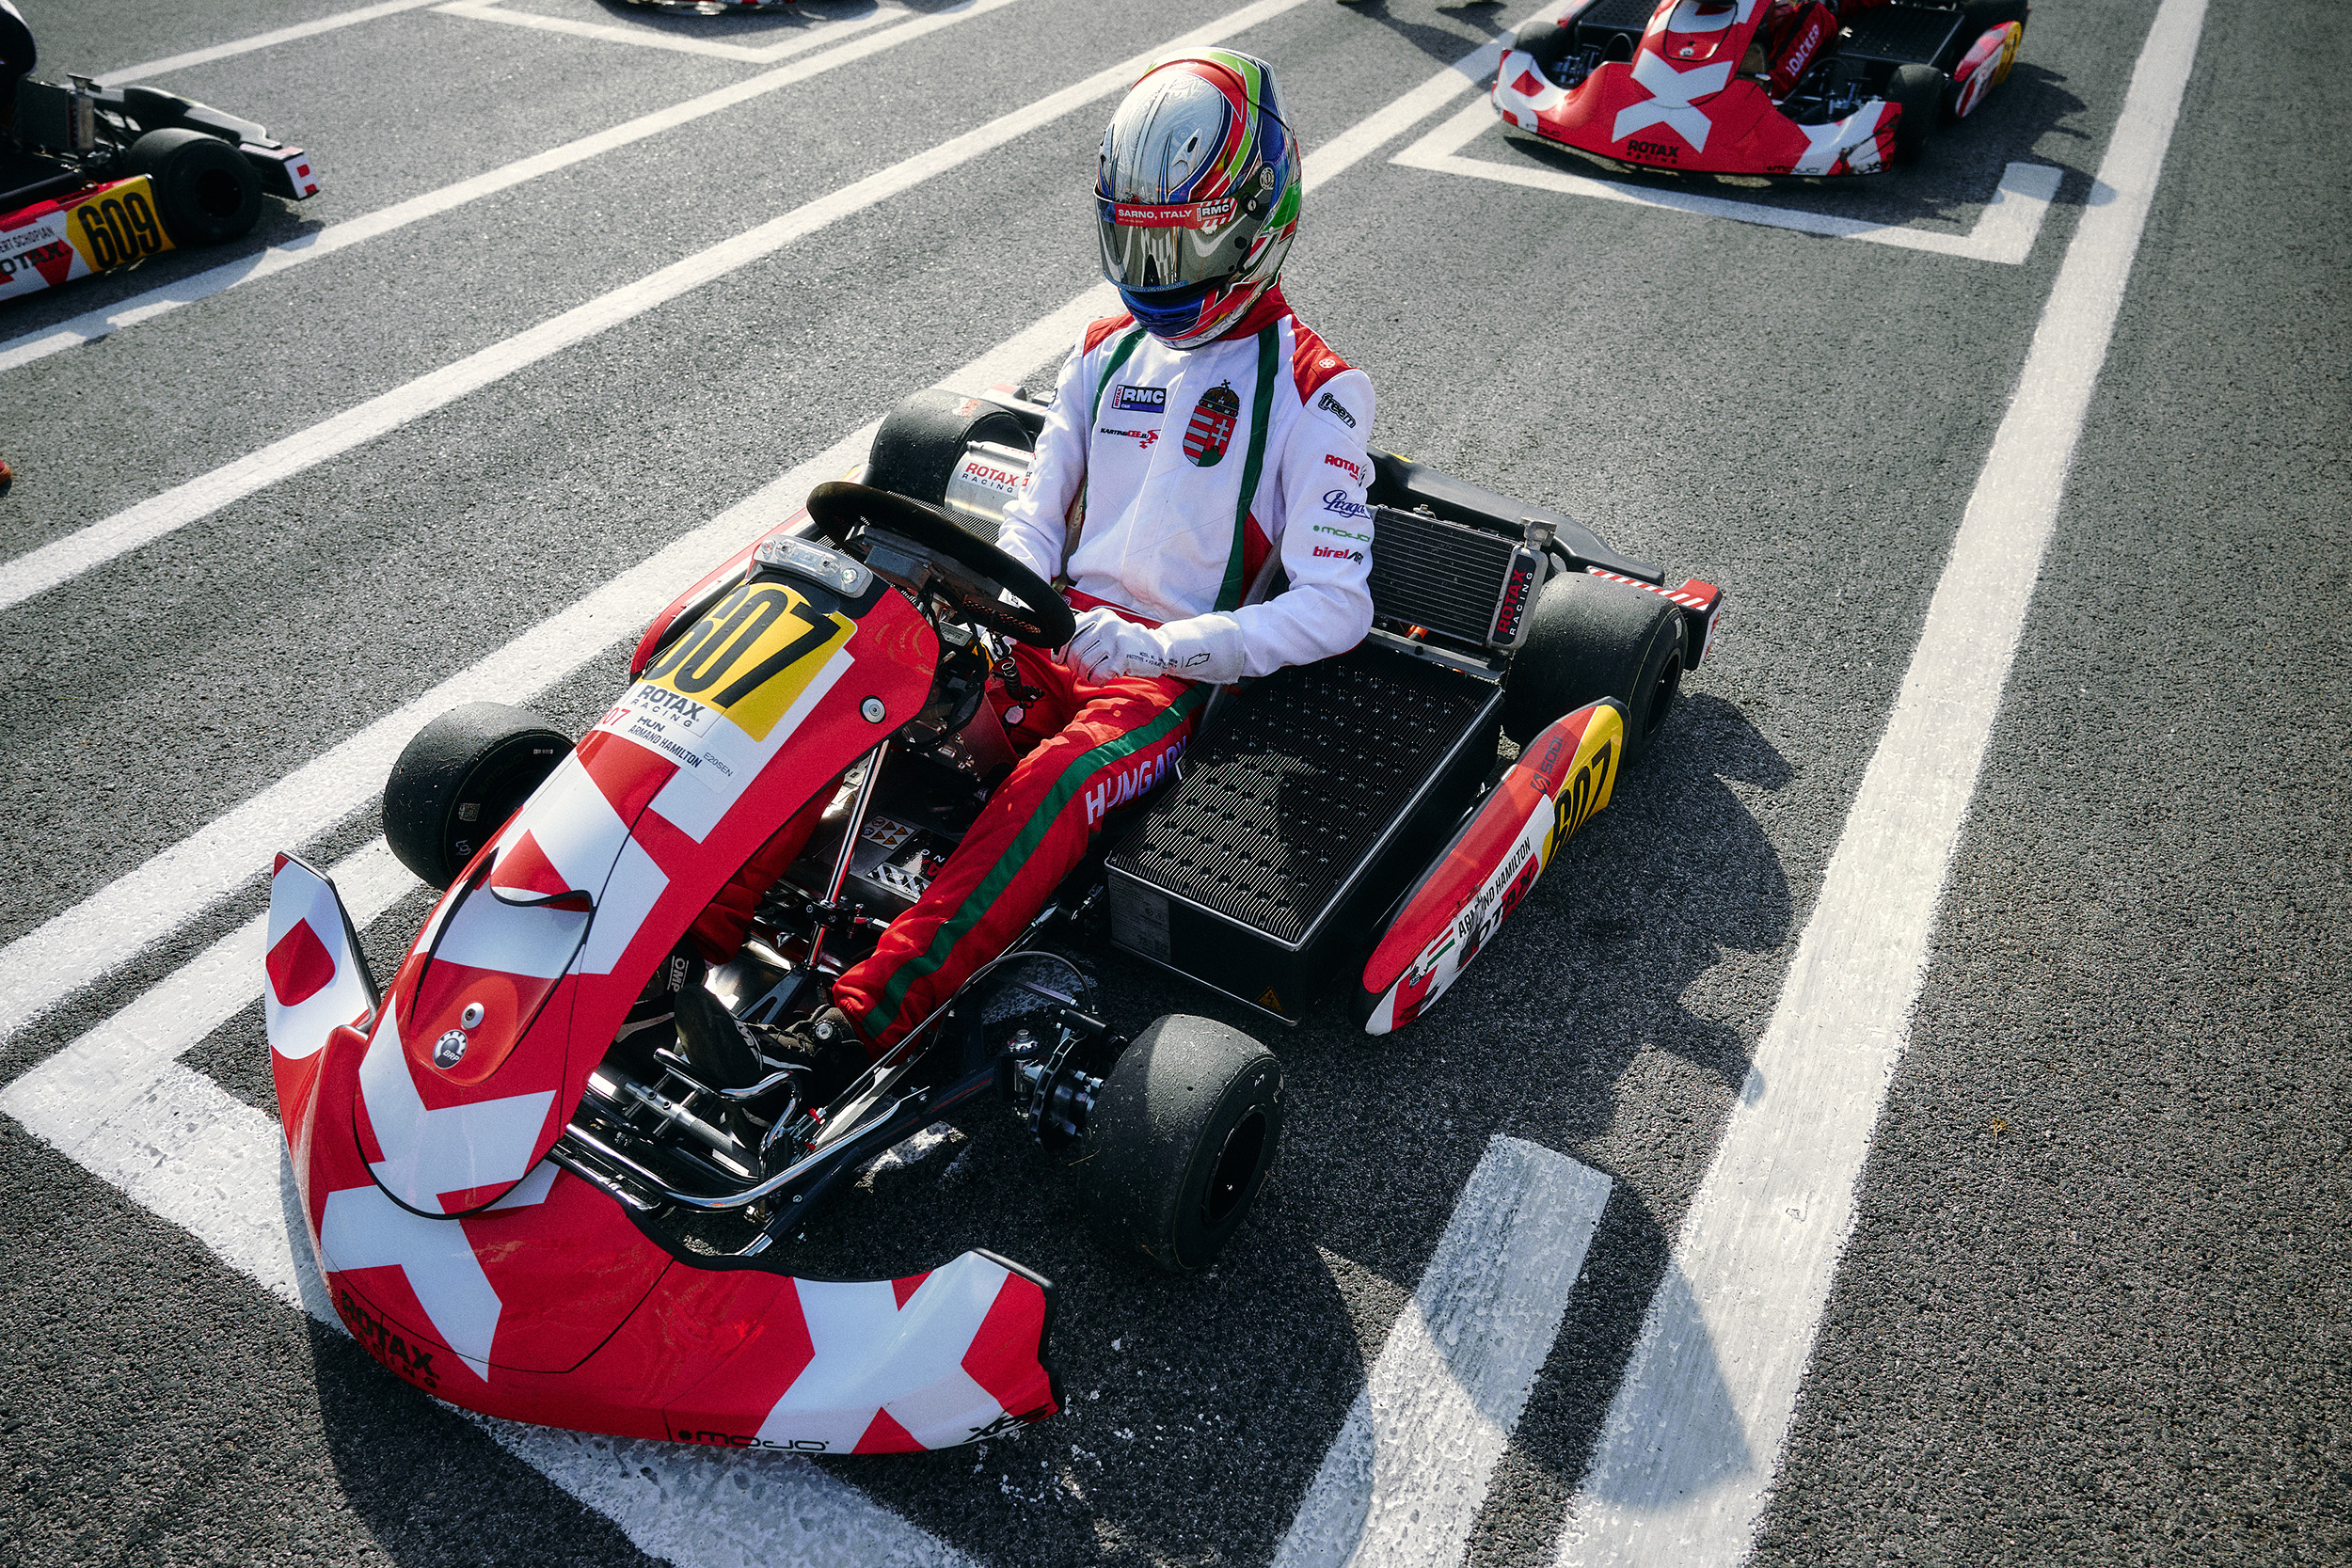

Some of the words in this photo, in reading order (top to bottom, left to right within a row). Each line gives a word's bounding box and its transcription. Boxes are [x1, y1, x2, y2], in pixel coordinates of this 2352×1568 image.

[1628, 139, 1679, 158] ROTAX
[1118, 209, 1158, 221] SARNO,
[1160, 209, 1193, 219] ITALY
[1201, 204, 1231, 217] RMC
[77, 191, 163, 269] 609
[1122, 388, 1166, 404] RMC
[1318, 392, 1357, 429] freem
[965, 462, 1020, 487] ROTAX
[1324, 453, 1360, 477] ROTAX
[961, 473, 1013, 494] RACING
[1496, 568, 1527, 633] ROTAX
[1509, 572, 1534, 636] RACING
[642, 584, 841, 709] 607
[630, 698, 692, 728] RACING
[637, 685, 706, 721] ROTAX
[637, 716, 666, 732] HUN
[628, 724, 662, 744] ARMAND
[659, 737, 703, 768] HAMILTON
[1540, 736, 1564, 774] SODI
[703, 752, 734, 777] E20SEN
[1085, 736, 1186, 825] HUNGARY
[1549, 738, 1612, 863] 607
[1458, 886, 1495, 938] ARMND
[1495, 836, 1531, 895] HAMILTON
[672, 958, 686, 992] OMP
[442, 1049, 460, 1061] BRP
[341, 1288, 434, 1374] ROTAX
[342, 1312, 437, 1389] RACING
